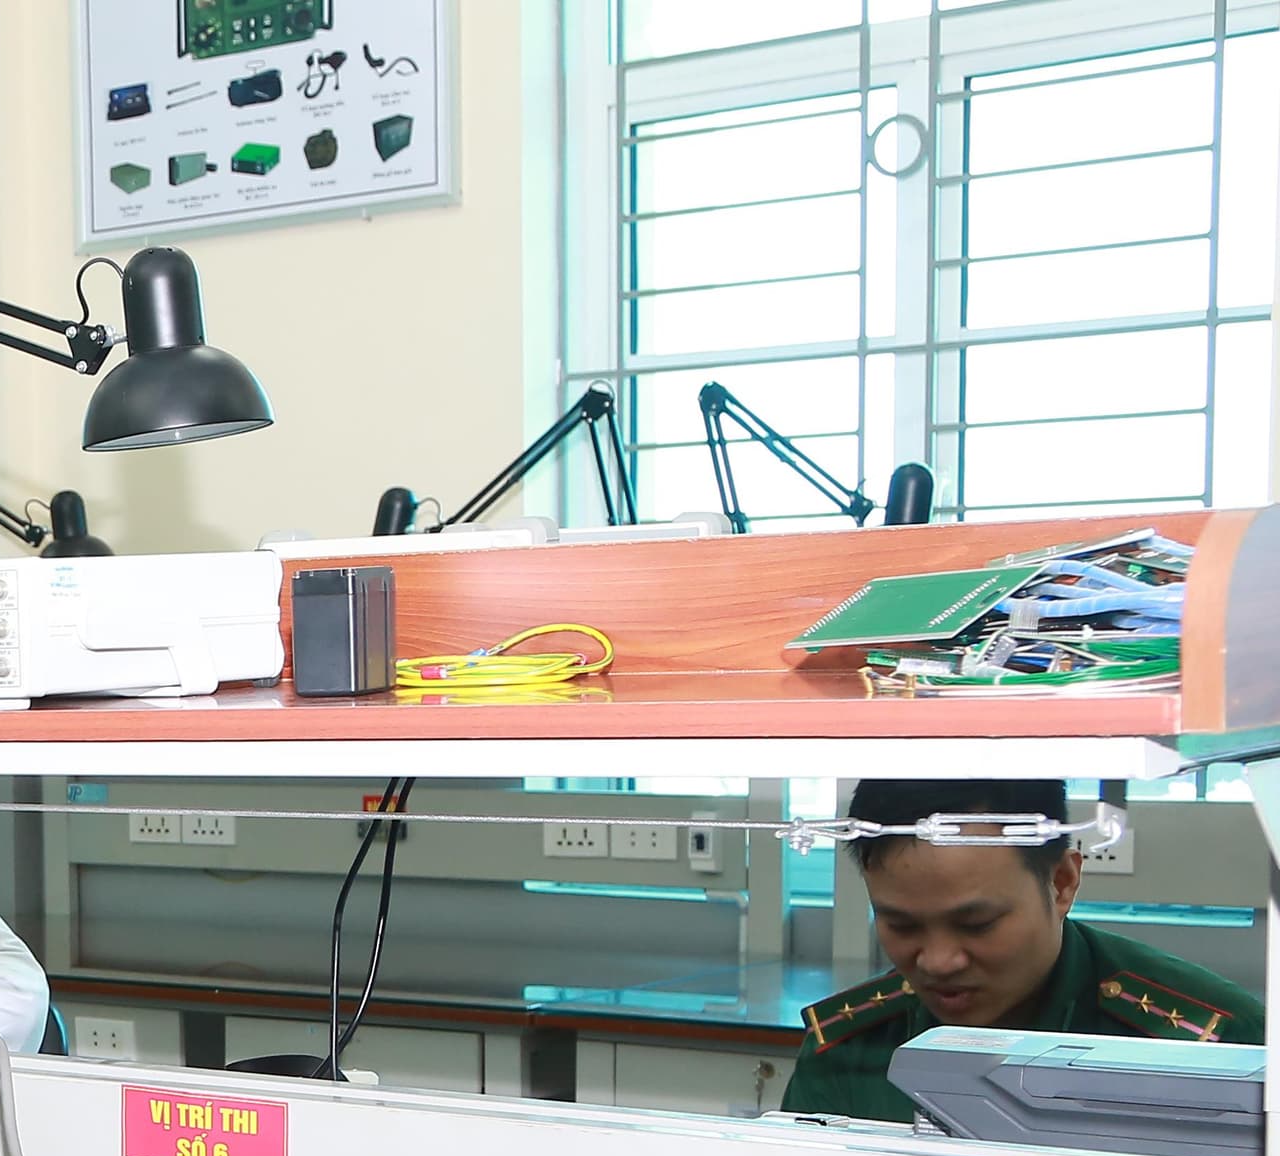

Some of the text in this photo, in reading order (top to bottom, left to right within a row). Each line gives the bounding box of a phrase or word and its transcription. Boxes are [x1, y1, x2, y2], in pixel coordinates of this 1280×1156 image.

[149, 1100, 258, 1135] VỊ TRÍ THI
